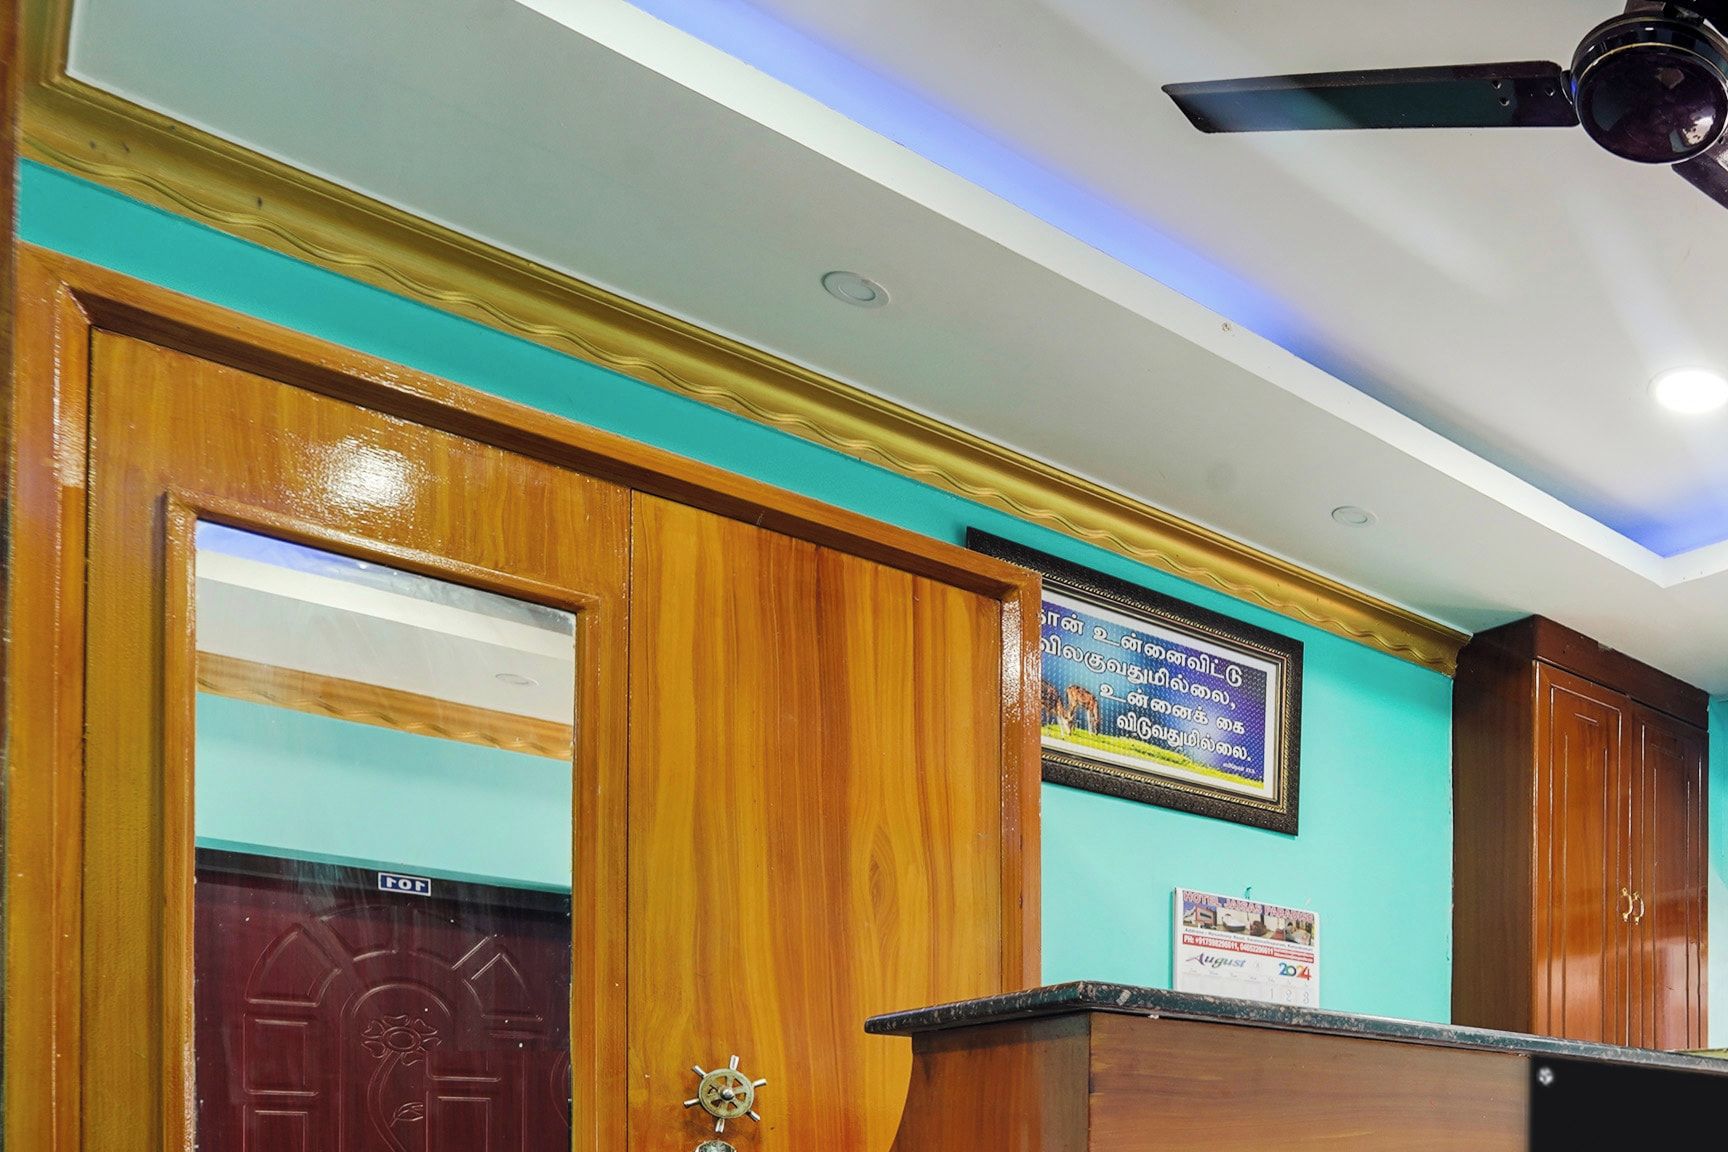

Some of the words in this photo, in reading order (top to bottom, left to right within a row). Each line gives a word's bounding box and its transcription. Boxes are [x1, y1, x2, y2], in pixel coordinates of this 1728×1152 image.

[1100, 683, 1209, 726] உன்னைக்
[1186, 953, 1247, 968] August
[1279, 962, 1312, 981] 2024
